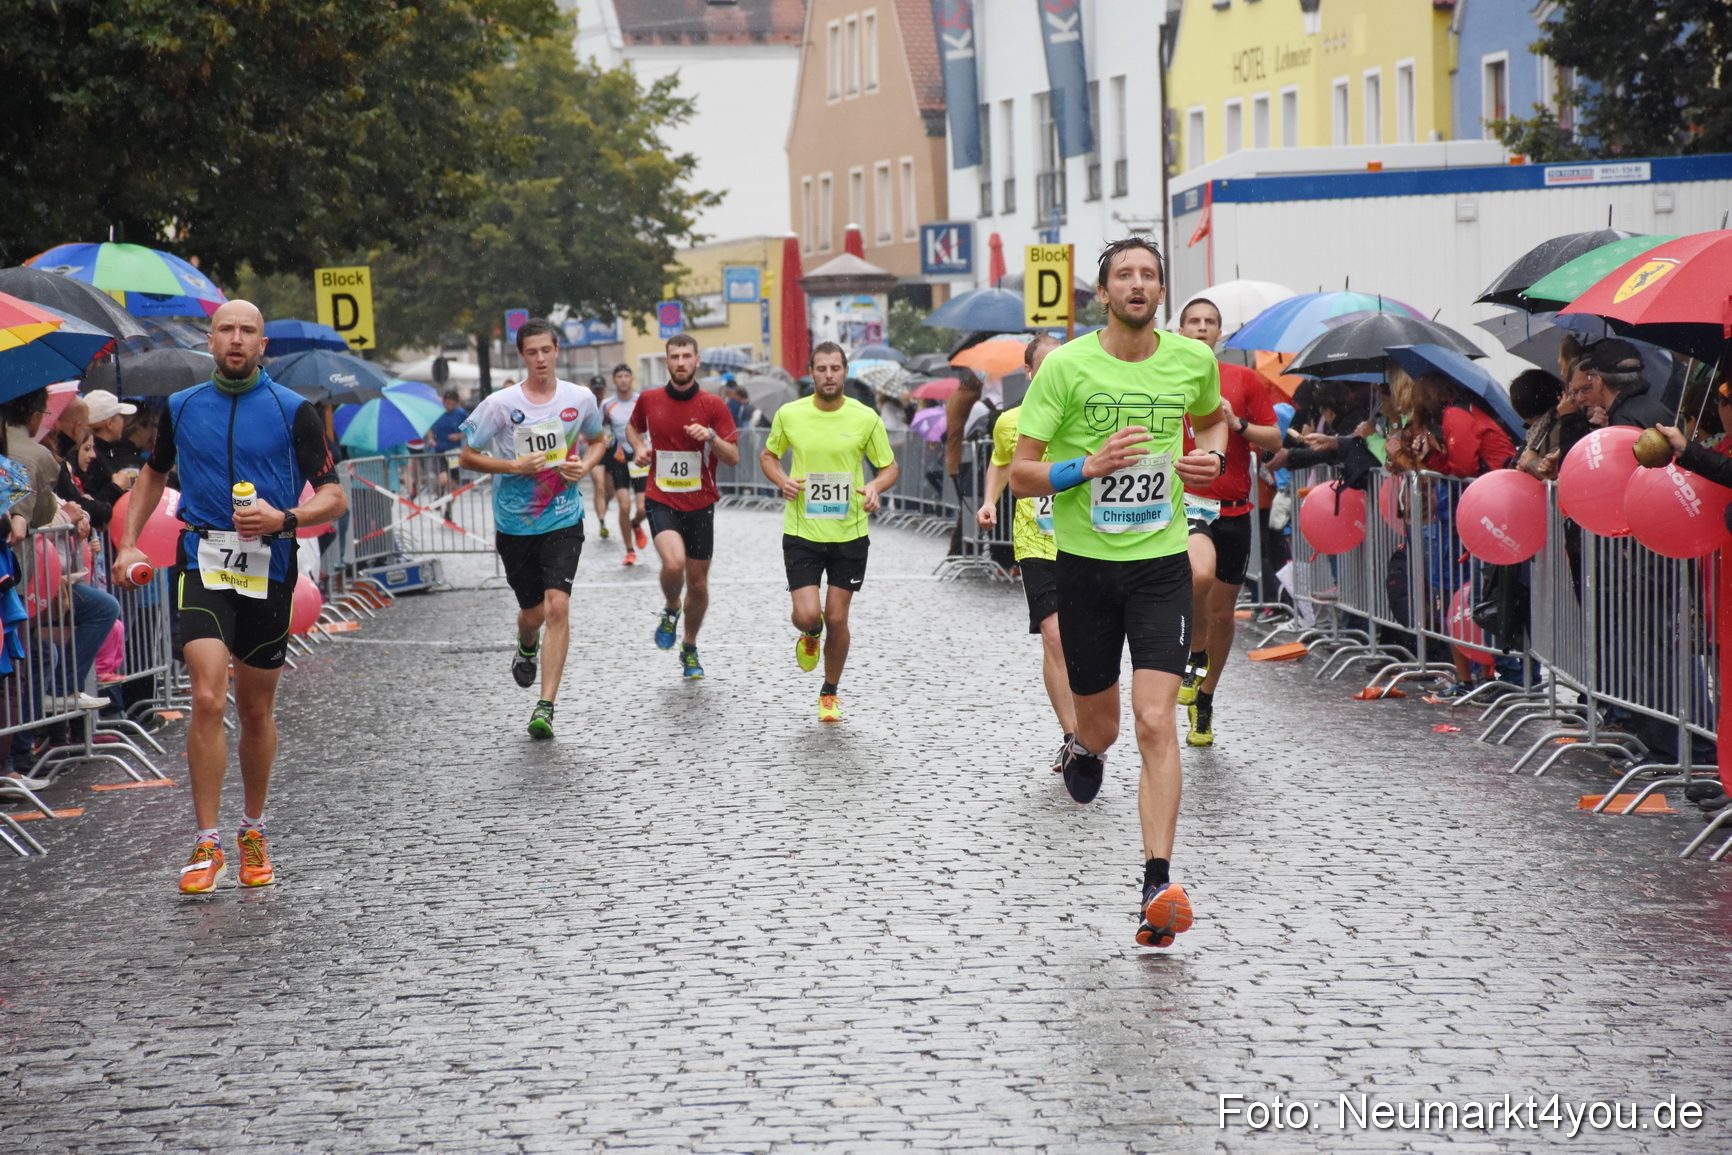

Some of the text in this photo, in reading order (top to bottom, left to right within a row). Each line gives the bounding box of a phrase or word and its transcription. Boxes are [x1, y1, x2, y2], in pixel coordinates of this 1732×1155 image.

[1232, 46, 1267, 85] HOTEL
[1030, 247, 1069, 262] Block
[322, 271, 364, 287] Block
[1038, 269, 1062, 308] D
[332, 293, 359, 331] D
[525, 432, 557, 453] 100
[670, 461, 689, 477] 48
[810, 484, 850, 501] 2511
[1100, 472, 1165, 503] 2232
[822, 505, 841, 513] Domi
[1103, 508, 1162, 524] Christopher
[219, 548, 248, 573] 74
[220, 573, 248, 588] Rhard
